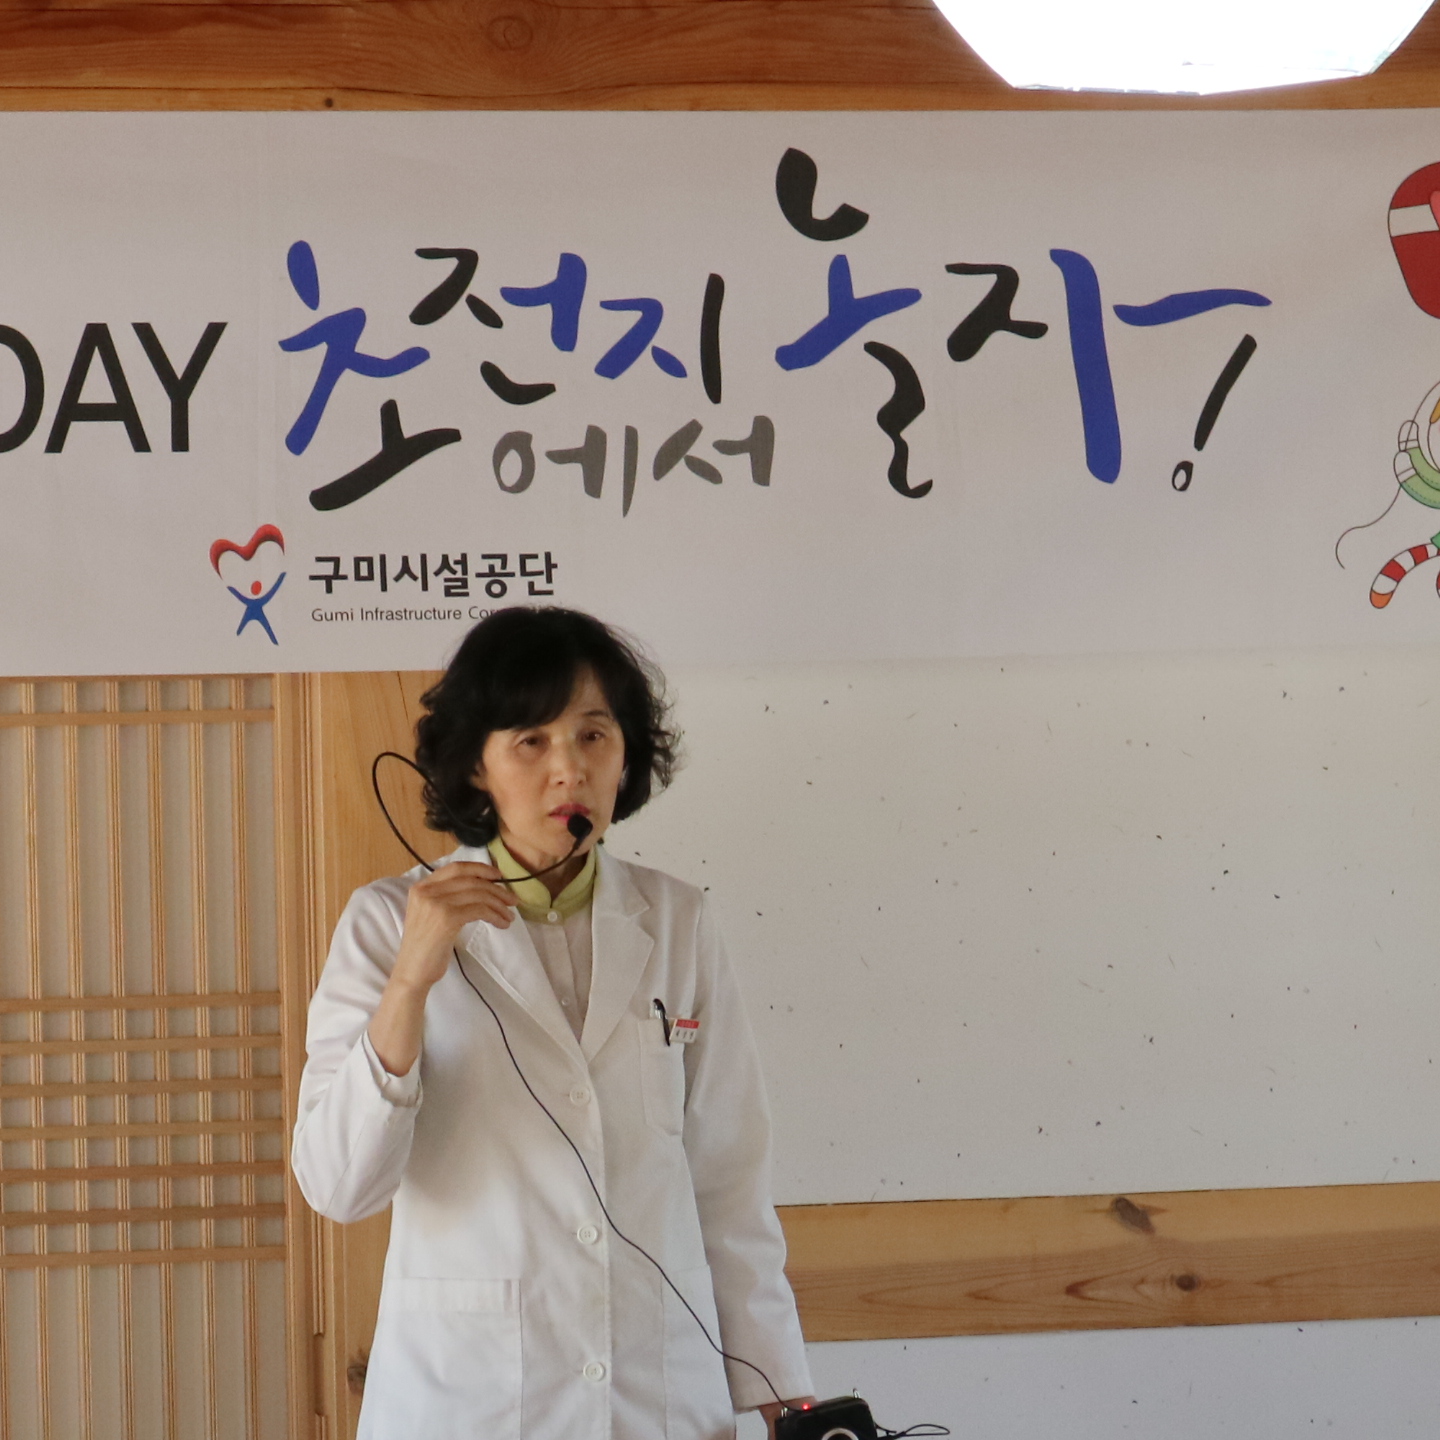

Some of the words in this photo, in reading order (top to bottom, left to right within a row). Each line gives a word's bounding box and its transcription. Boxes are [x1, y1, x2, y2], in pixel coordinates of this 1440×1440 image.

[277, 240, 726, 512] 초전지
[492, 414, 776, 518] 에서
[308, 551, 559, 599] 구미시설공단
[311, 607, 354, 622] Gumi
[360, 606, 463, 622] Infrastructure
